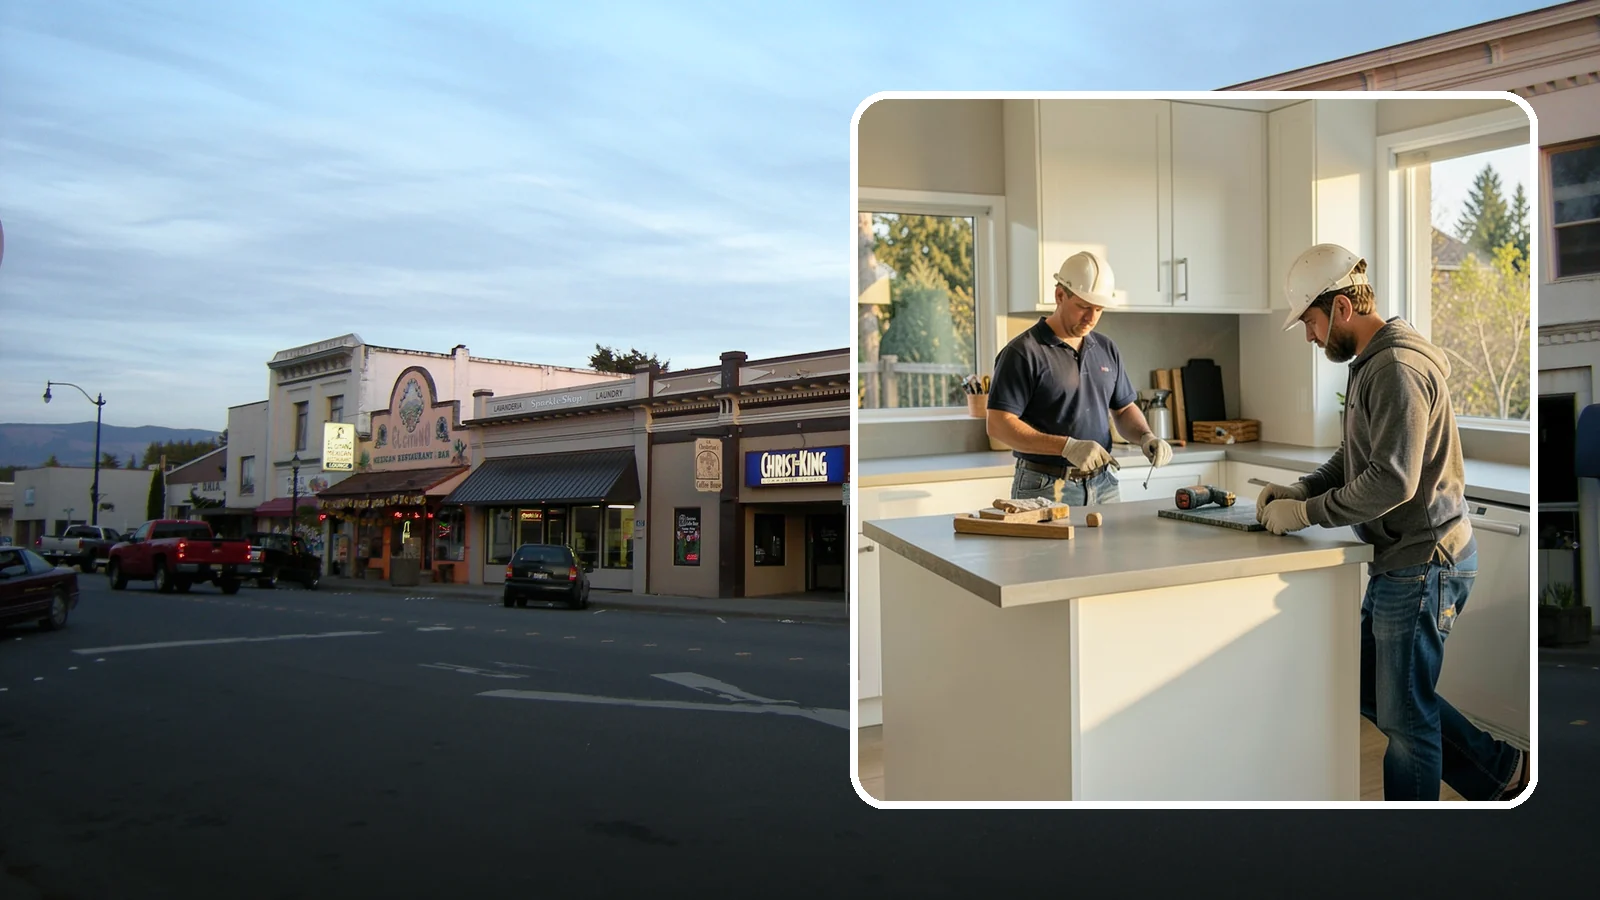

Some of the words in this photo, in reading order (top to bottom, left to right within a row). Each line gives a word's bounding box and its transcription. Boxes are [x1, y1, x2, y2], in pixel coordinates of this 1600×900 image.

[596, 389, 623, 399] LAUNDRY
[494, 402, 522, 412] LAVANDERIA
[531, 397, 561, 409] Sparkle
[562, 395, 582, 404] Shop
[373, 454, 396, 464] MEXICAN
[397, 451, 434, 462] RESTAURANT
[438, 450, 450, 459] BAR
[761, 452, 797, 477] CHRIST
[799, 450, 827, 476] KING
